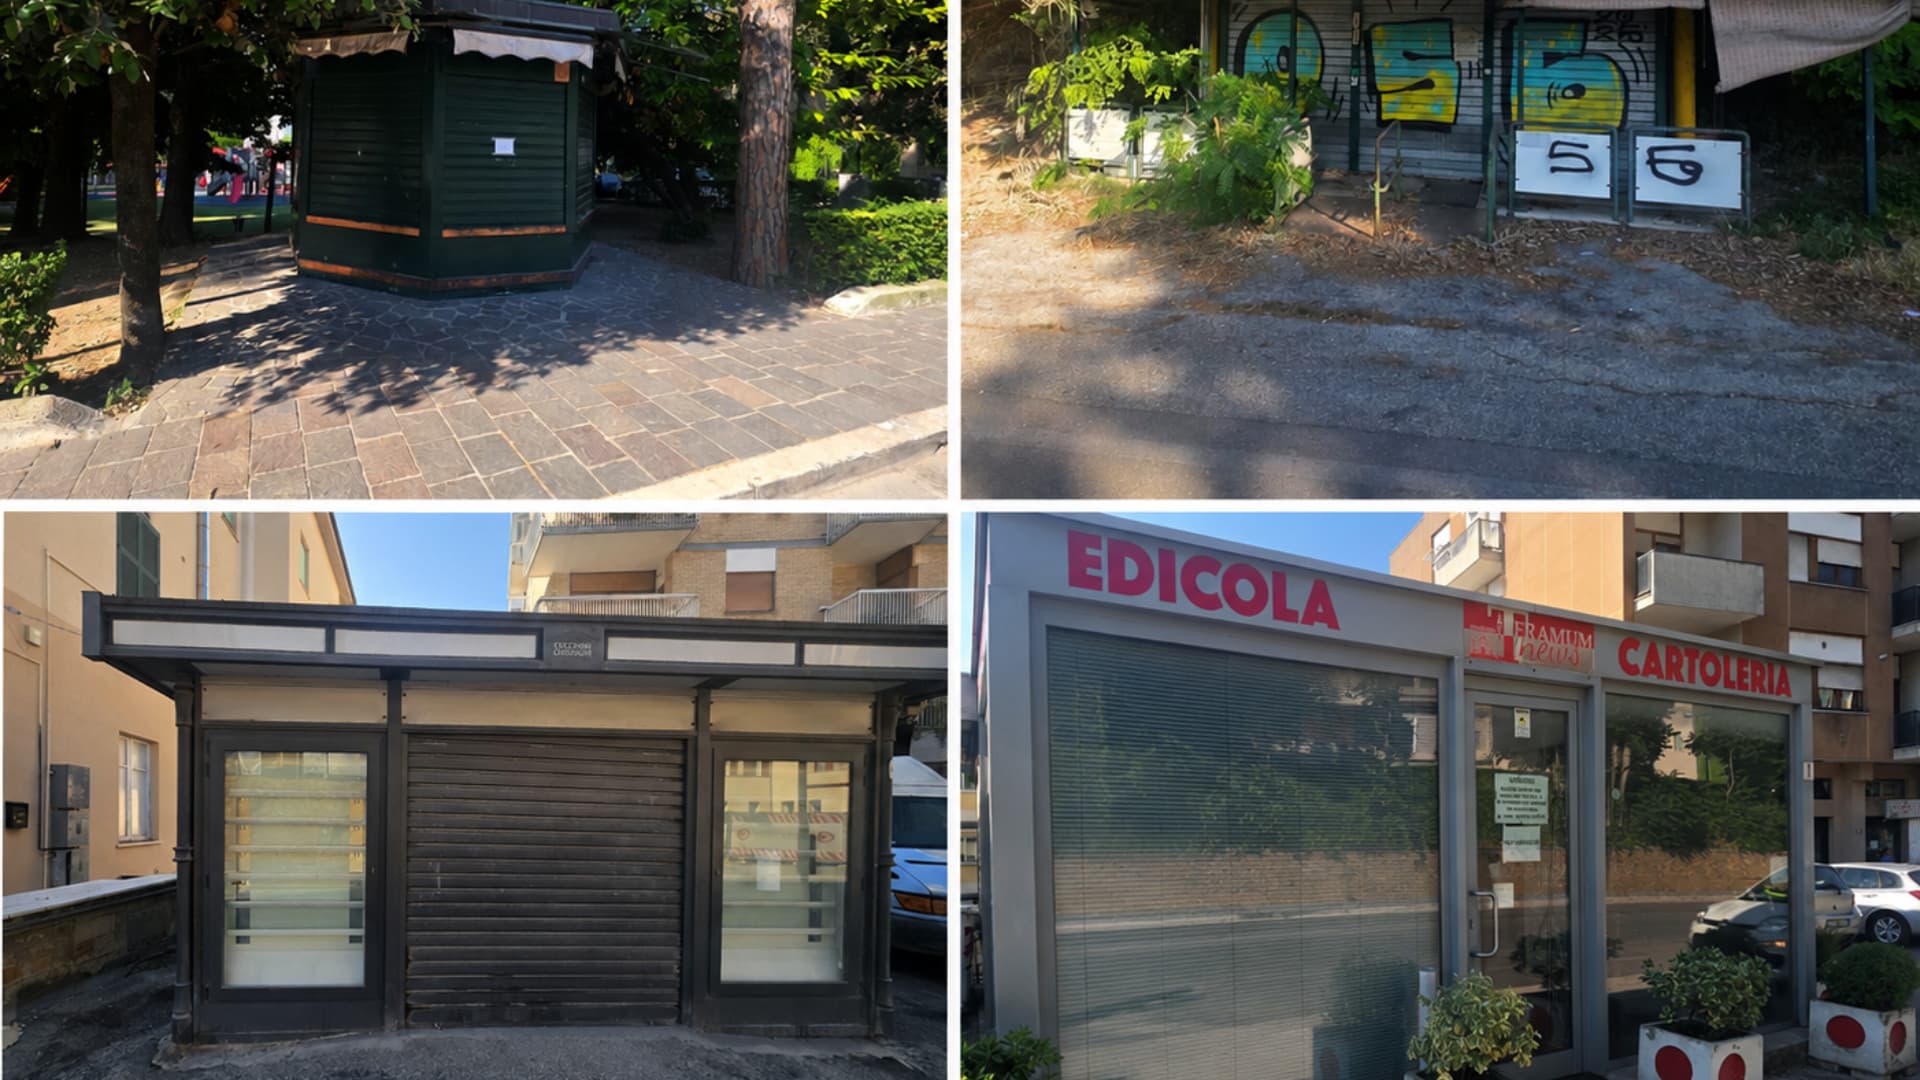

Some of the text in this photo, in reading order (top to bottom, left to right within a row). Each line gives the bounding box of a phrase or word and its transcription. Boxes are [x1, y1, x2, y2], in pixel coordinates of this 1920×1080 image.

[1067, 529, 1341, 630] EDICOLA
[1487, 603, 1593, 650] TERAMUM
[1618, 636, 1792, 698] CARTOLERIA
